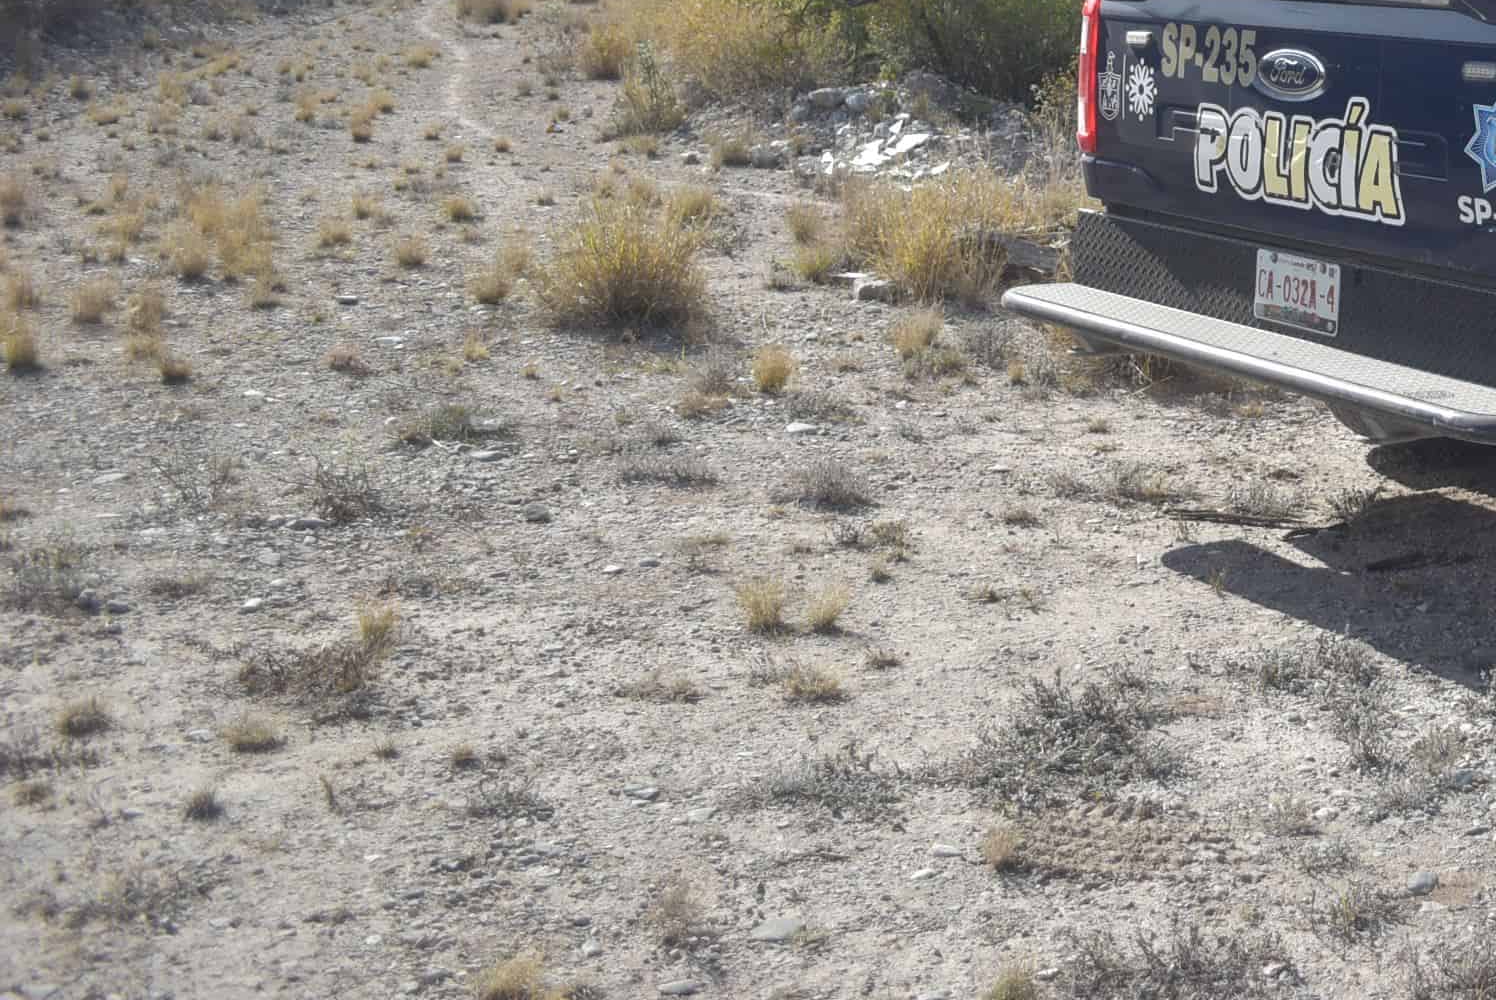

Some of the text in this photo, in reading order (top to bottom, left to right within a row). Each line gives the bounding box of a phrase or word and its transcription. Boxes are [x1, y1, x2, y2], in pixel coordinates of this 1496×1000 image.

[1161, 22, 1257, 87] SP-235
[1270, 57, 1308, 85] Ford
[1195, 98, 1405, 225] POLICÍA
